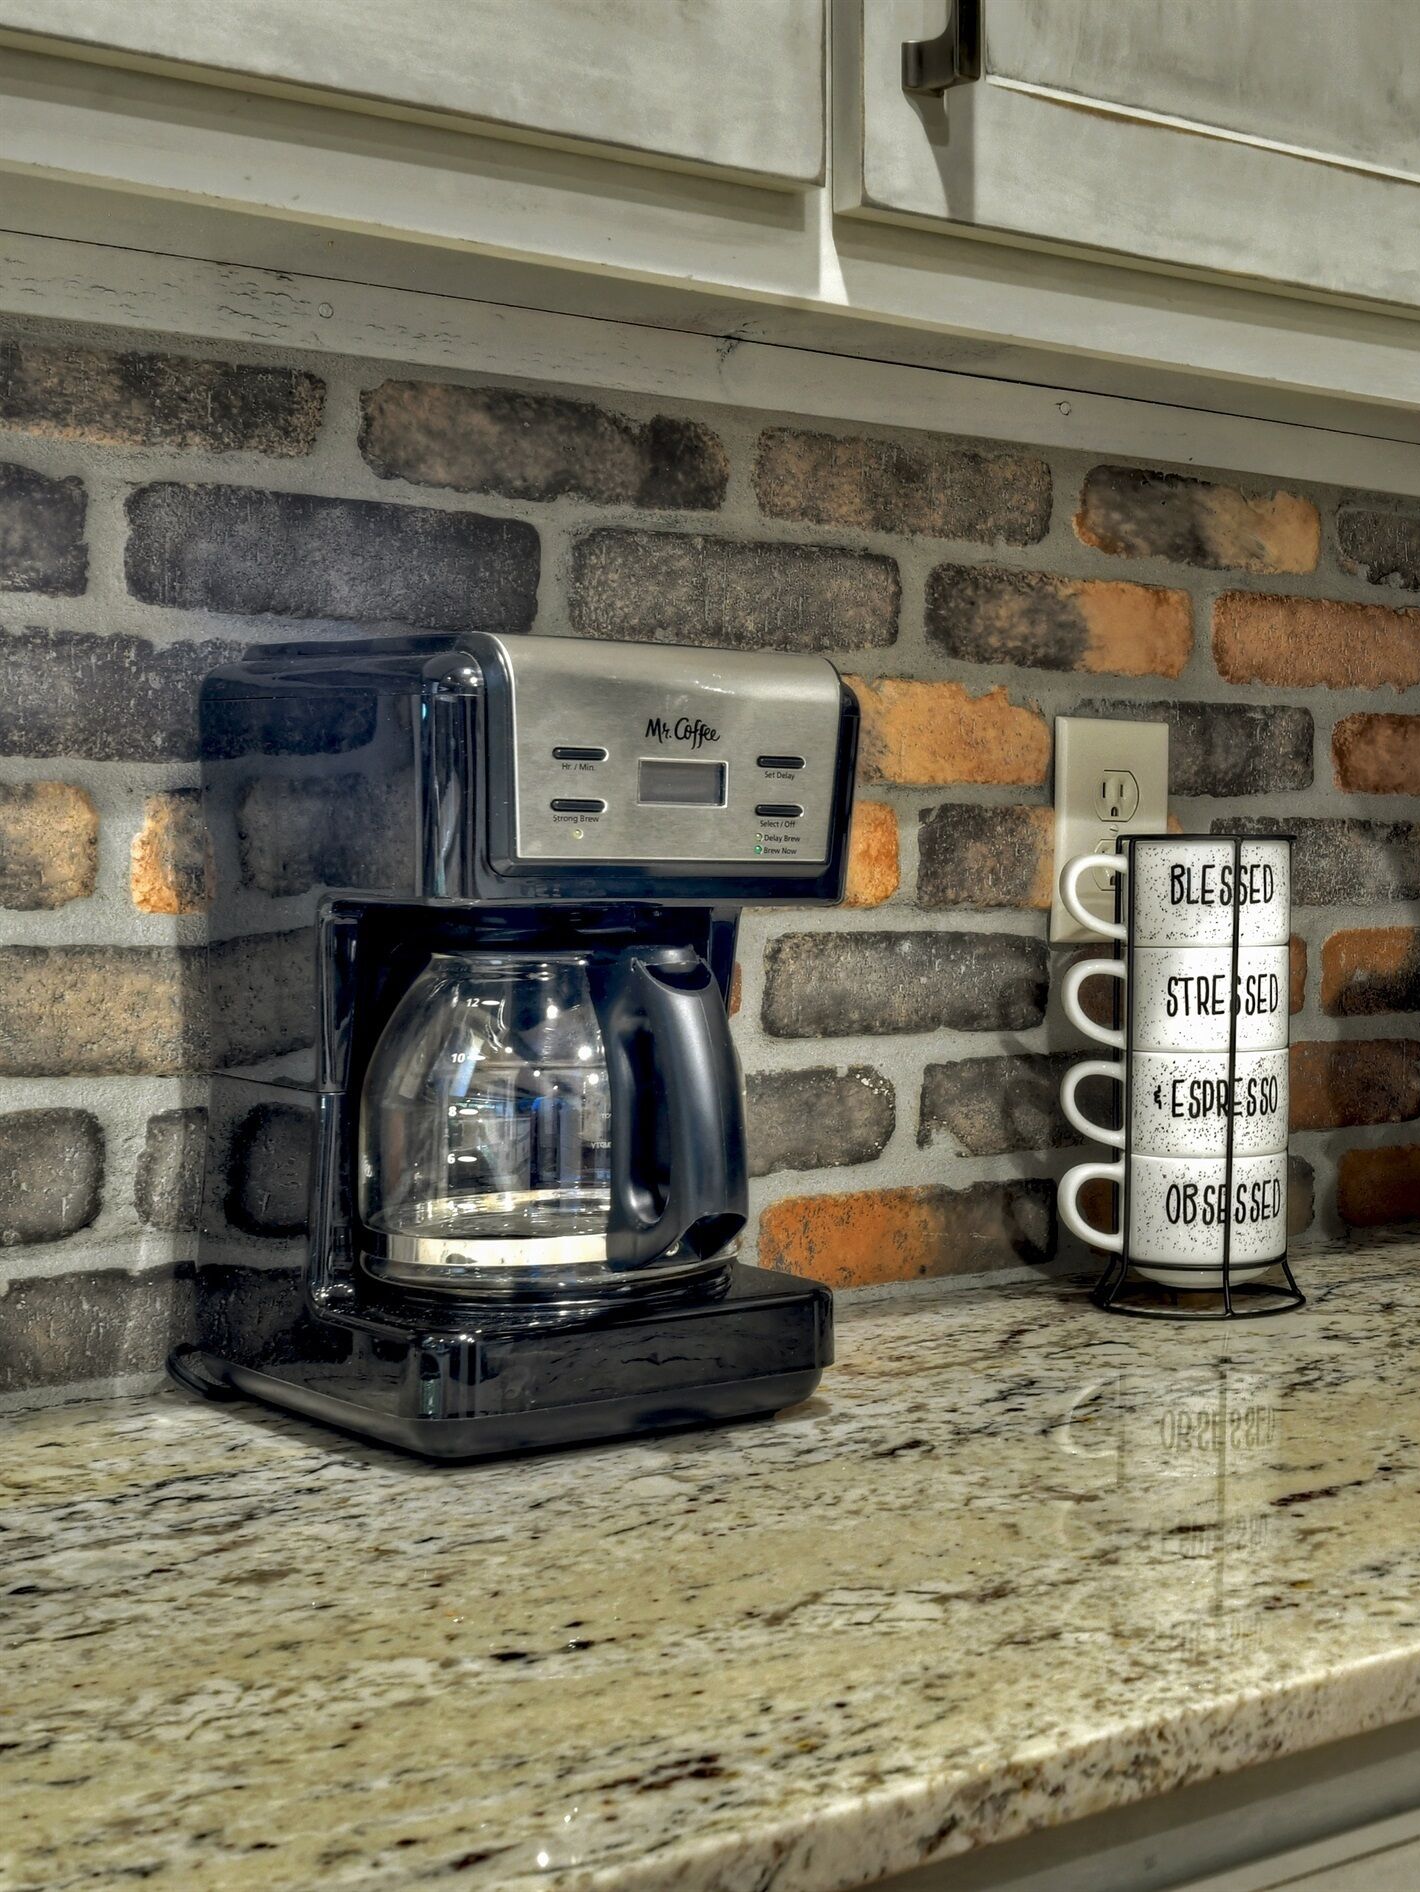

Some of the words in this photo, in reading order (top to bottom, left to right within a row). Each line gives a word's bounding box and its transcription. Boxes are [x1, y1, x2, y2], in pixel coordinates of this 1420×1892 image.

[645, 717, 672, 744] Mr.
[674, 717, 720, 750] Coffee
[764, 771, 776, 779] Set
[777, 772, 795, 781] Delay
[553, 815, 578, 824] Strong
[580, 815, 600, 823] Brew
[760, 821, 779, 829] Select
[784, 821, 796, 829] Off
[764, 835, 782, 844] Delay
[784, 835, 801, 843] Brew
[764, 847, 780, 855] Brew
[782, 848, 798, 856] Now
[1170, 863, 1275, 907] BLESSED
[1166, 972, 1279, 1018] STRESSED
[466, 998, 481, 1008] 12
[451, 1053, 466, 1064] 10
[1172, 1075, 1278, 1119] ESPRESSO
[448, 1105, 458, 1117] 8
[447, 1153, 456, 1164] 6
[1166, 1178, 1280, 1226] OBSESSED
